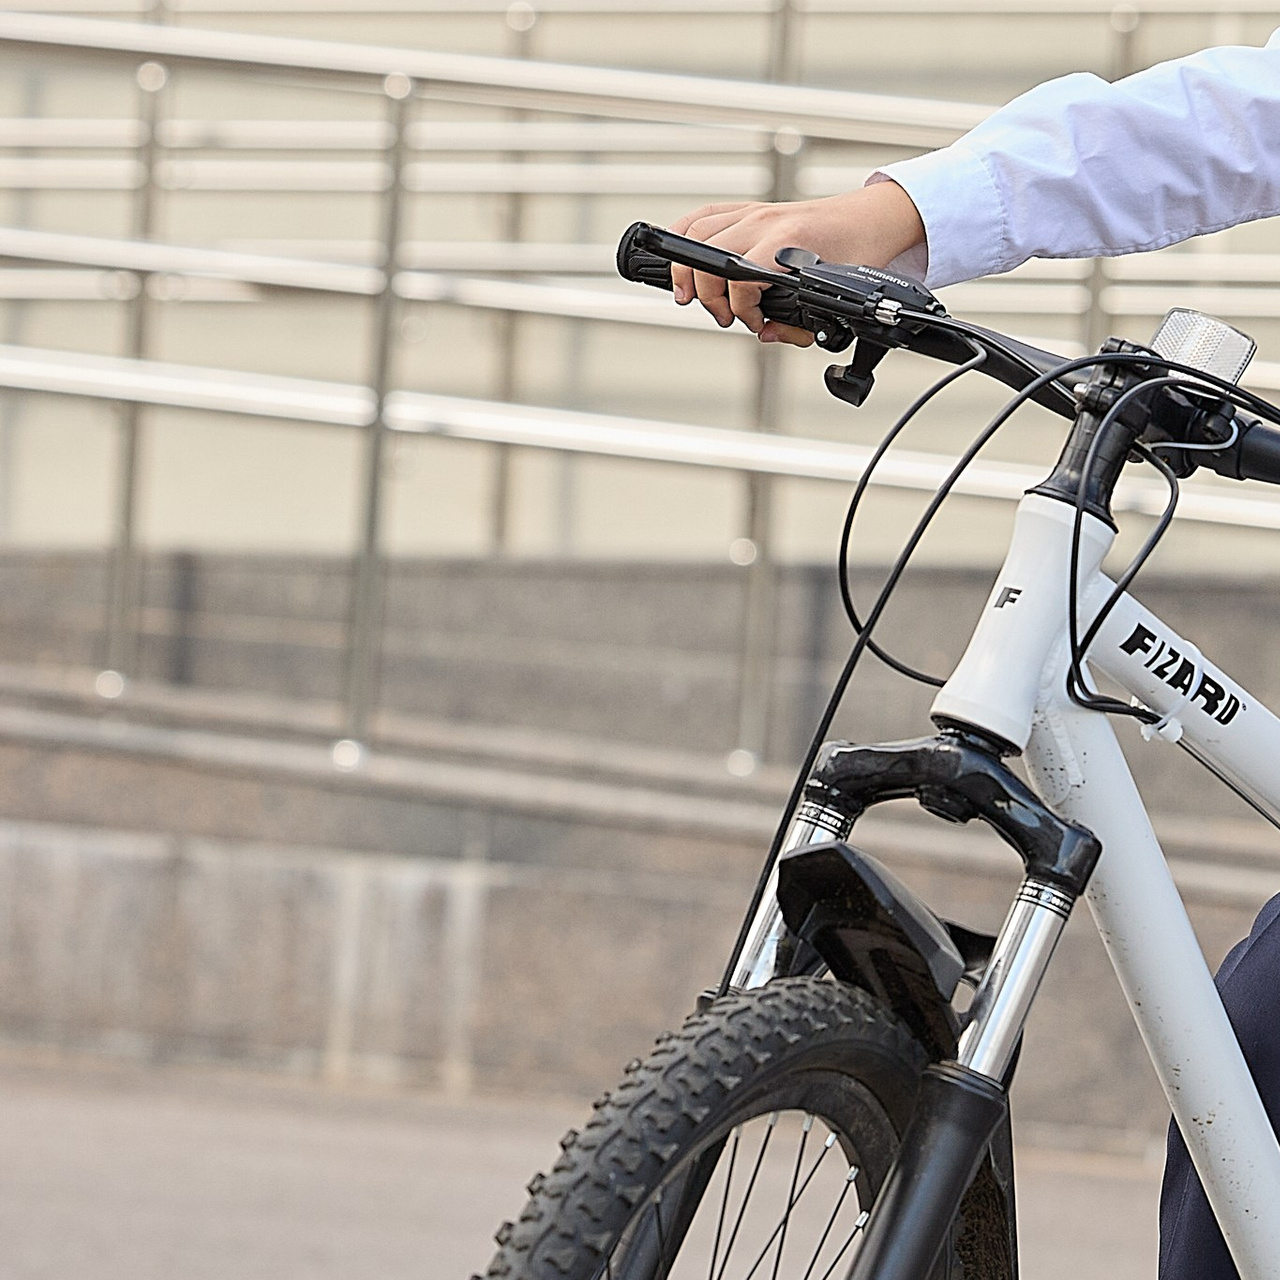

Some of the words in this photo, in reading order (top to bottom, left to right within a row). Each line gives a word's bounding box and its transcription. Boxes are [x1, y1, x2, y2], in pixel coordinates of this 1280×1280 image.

[857, 266, 910, 288] SHIMANO
[993, 586, 1022, 608] F
[1118, 622, 1241, 726] FIZARD
